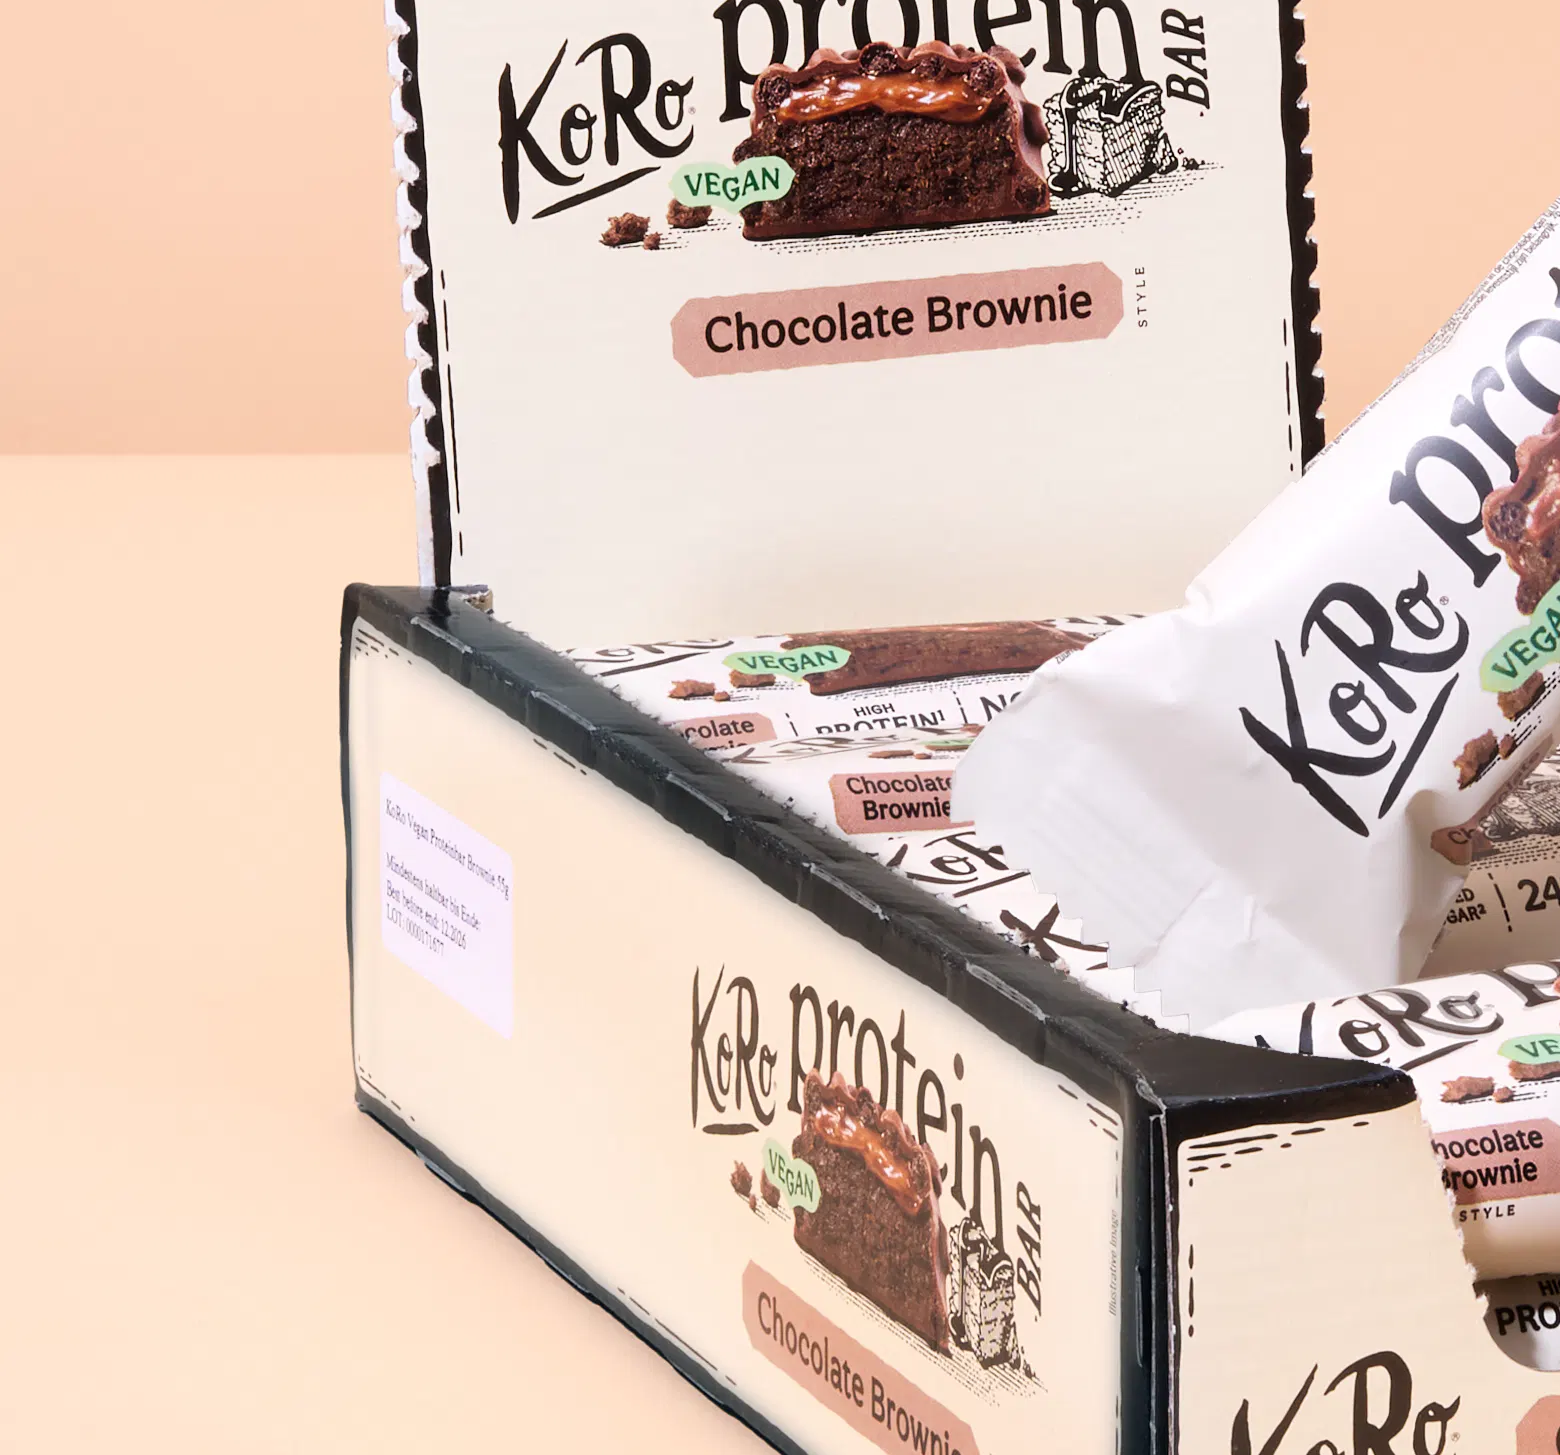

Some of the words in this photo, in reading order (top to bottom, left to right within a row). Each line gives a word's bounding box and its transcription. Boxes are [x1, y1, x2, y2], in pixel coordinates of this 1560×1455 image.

[1161, 7, 1209, 111] BAR
[498, 33, 694, 224] KoRo
[683, 166, 782, 203] VEGAN
[705, 301, 915, 355] Chocolate
[926, 285, 1093, 333] Brownie
[1134, 266, 1148, 328] STYLE
[738, 650, 838, 673] VEGAN
[680, 718, 755, 739] colate
[854, 703, 895, 717] HIGH
[1239, 569, 1470, 837] KoRo
[407, 812, 429, 840] Vegan
[430, 828, 466, 867] Proteinbar
[467, 853, 500, 887] Brownie
[690, 963, 778, 1129] KoRo
[788, 981, 1003, 1271] protein
[1431, 1129, 1544, 1160] hocolate
[769, 1148, 814, 1202] VEGAN
[1459, 1204, 1516, 1222] STYLE
[1017, 1181, 1042, 1316] BAR
[757, 1291, 864, 1408] Chocolate
